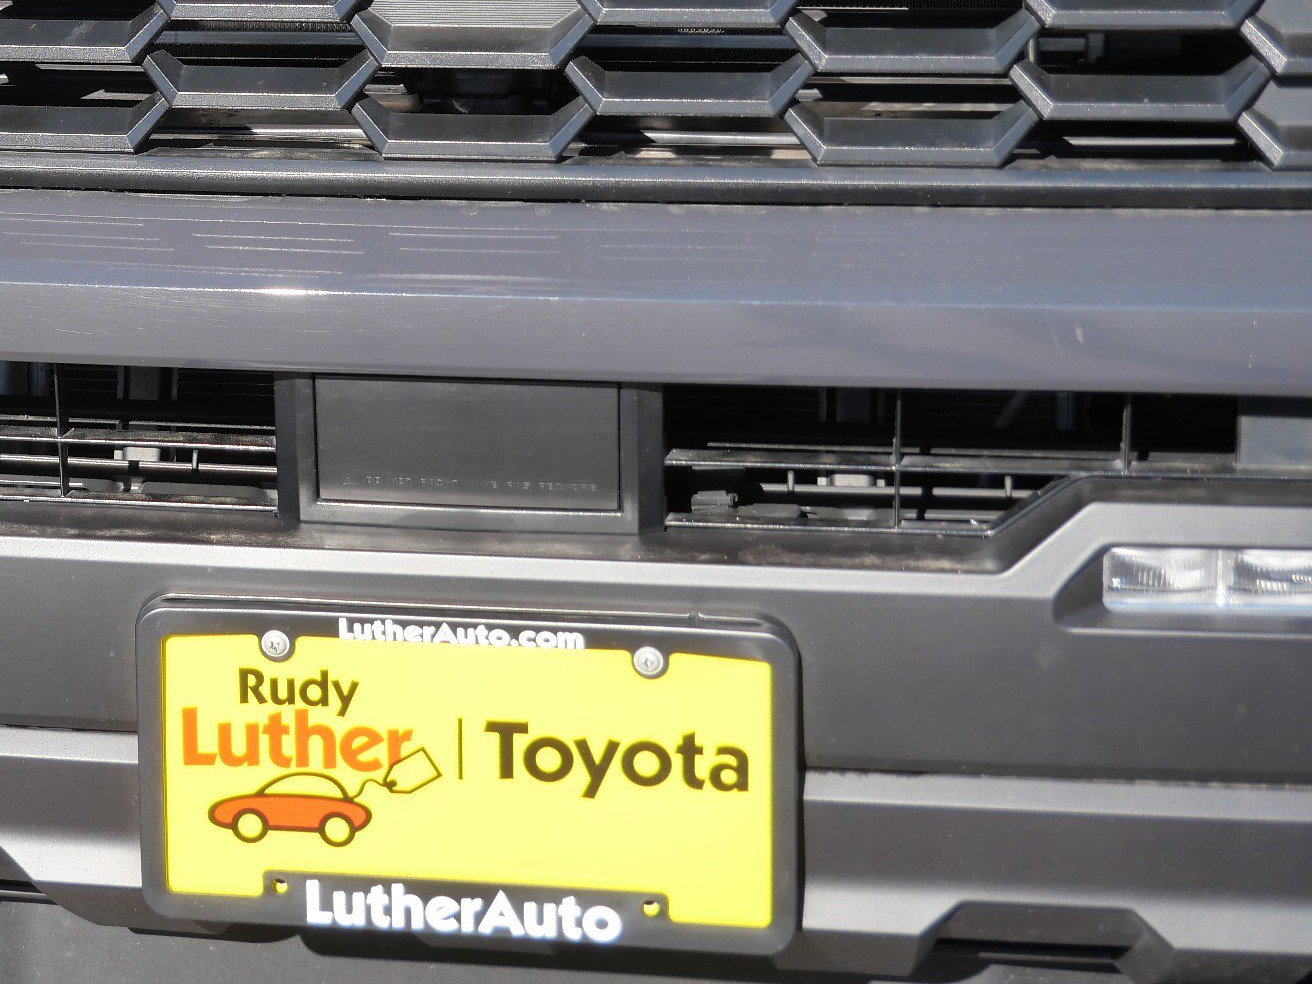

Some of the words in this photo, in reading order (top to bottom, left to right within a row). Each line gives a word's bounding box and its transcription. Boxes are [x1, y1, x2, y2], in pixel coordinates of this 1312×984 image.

[338, 617, 586, 651] LutherAuto.com
[237, 667, 360, 717] Rudy
[181, 706, 414, 773] Luther
[484, 720, 751, 799] Toyota
[304, 879, 624, 945] LutherAuto
